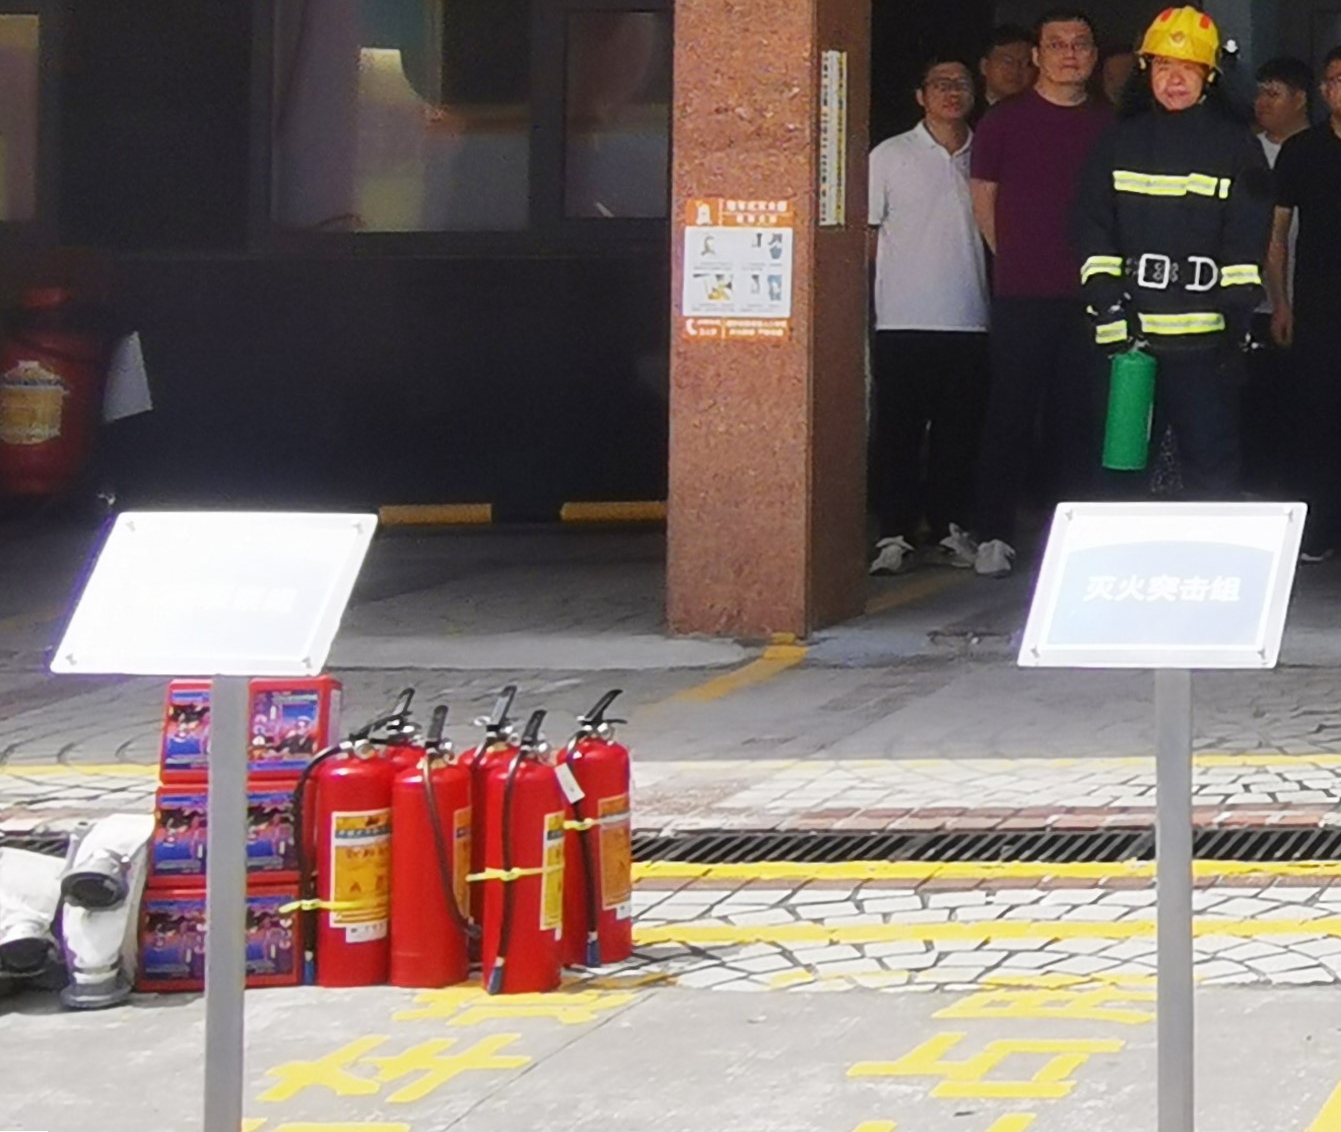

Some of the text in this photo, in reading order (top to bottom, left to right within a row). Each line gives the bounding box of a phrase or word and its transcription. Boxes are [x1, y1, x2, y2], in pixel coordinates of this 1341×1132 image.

[1083, 574, 1241, 602] 灭火突击组
